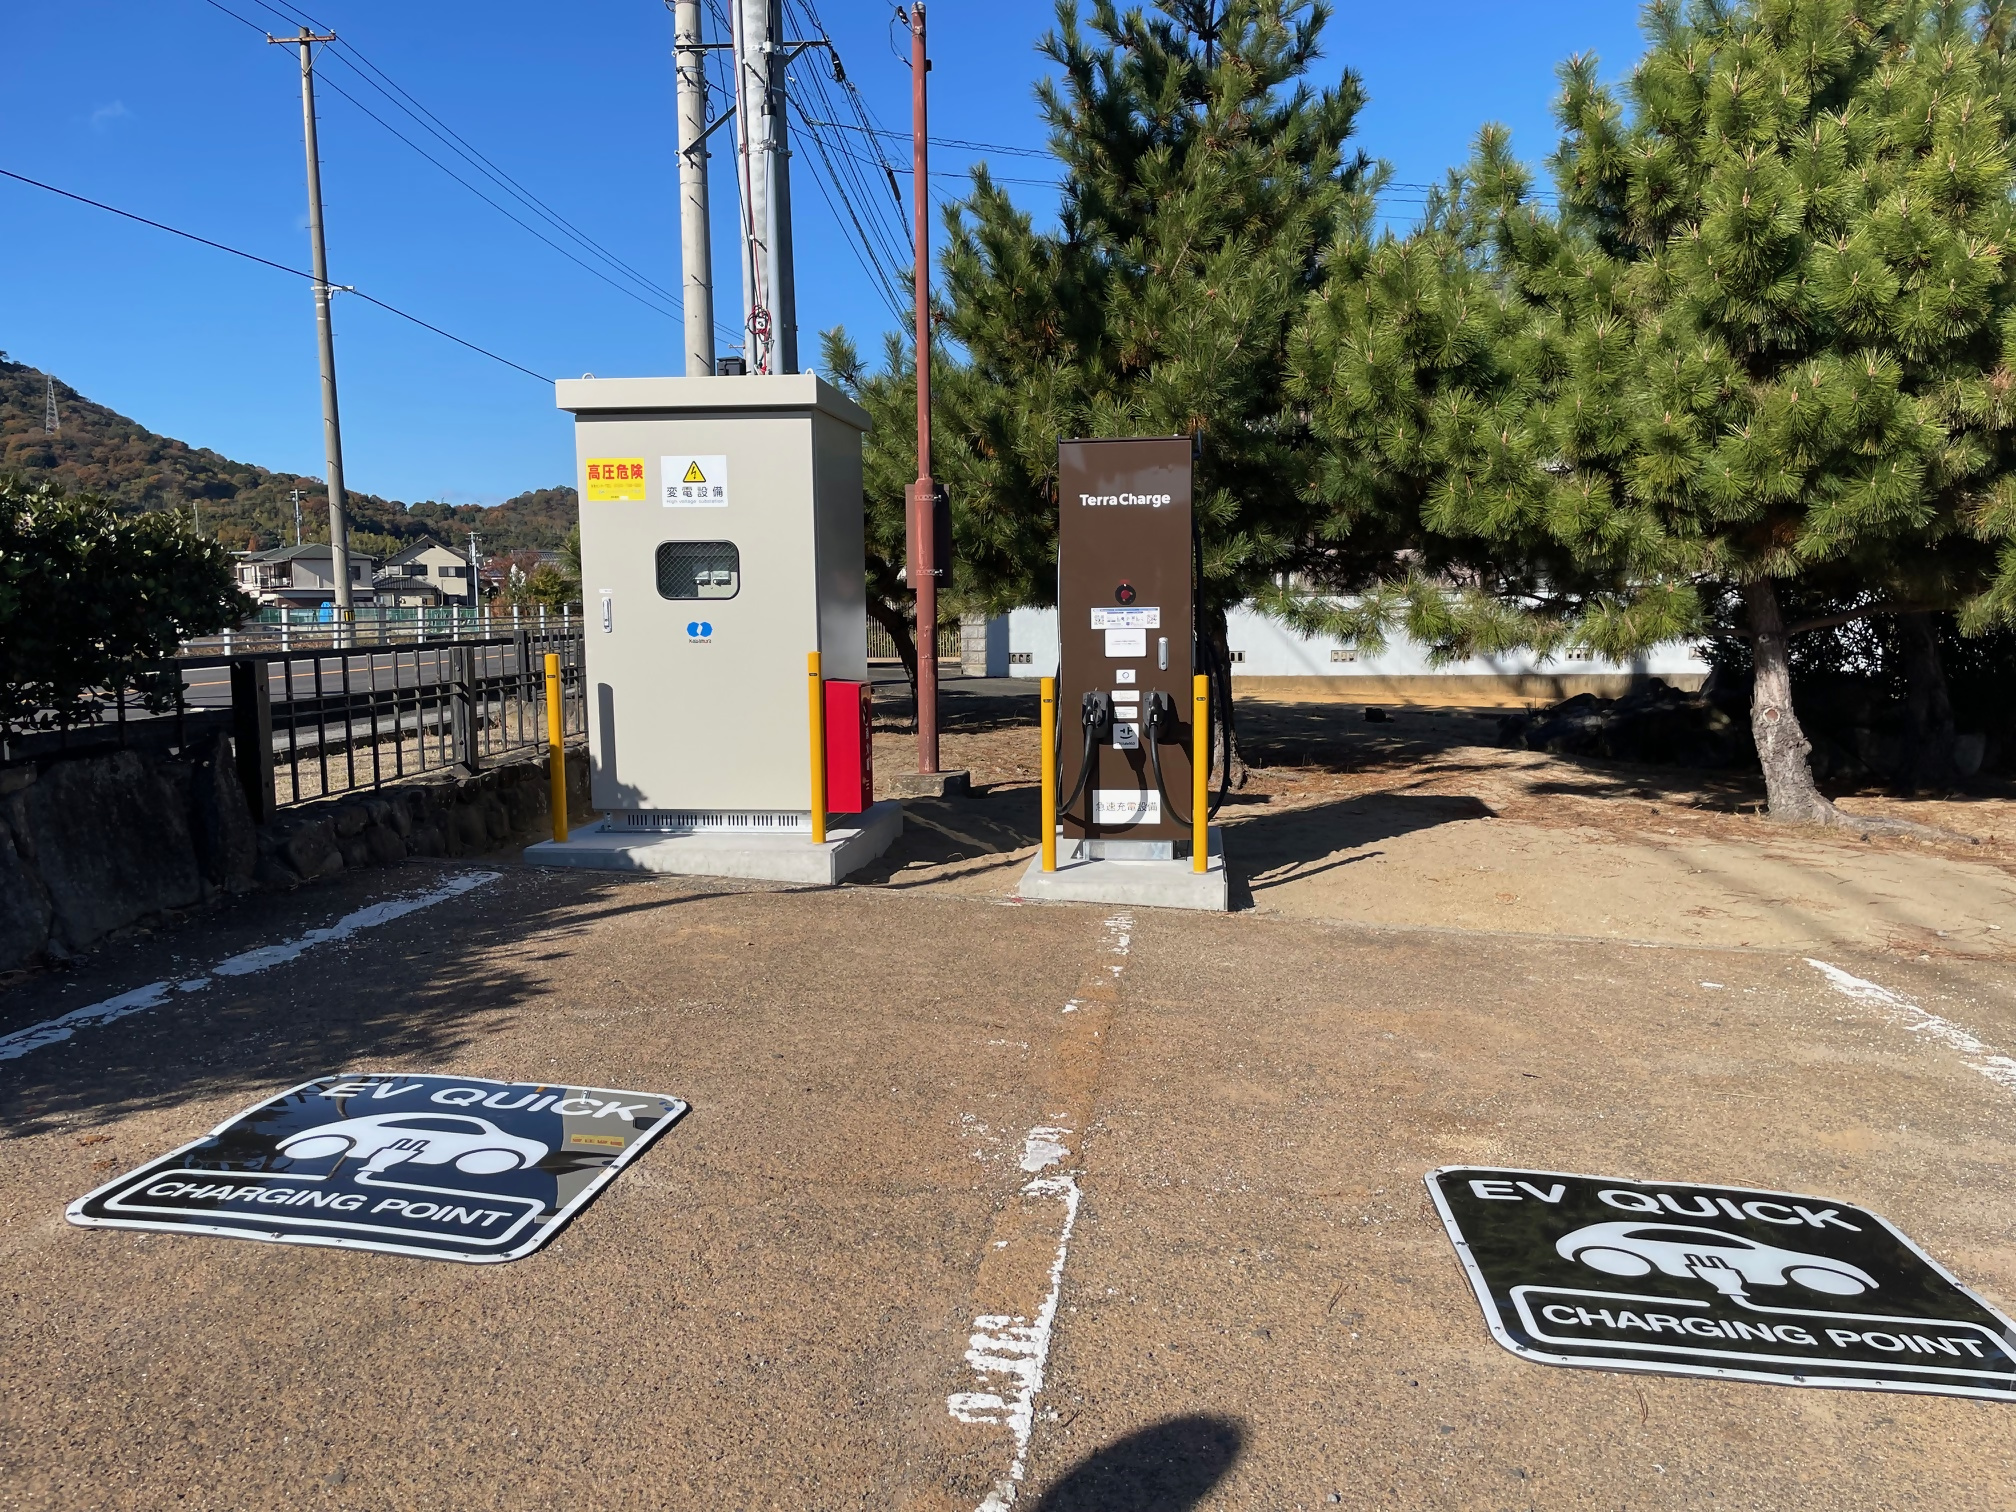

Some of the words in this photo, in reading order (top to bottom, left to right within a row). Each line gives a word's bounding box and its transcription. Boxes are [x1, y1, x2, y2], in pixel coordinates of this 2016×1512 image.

[588, 464, 643, 480] 高圧危険
[666, 486, 723, 498] 変電設備
[1095, 801, 1158, 812] 急速充電設備
[319, 1082, 424, 1099] EV
[430, 1087, 649, 1121] QUICK
[146, 1182, 368, 1211] CHARGING
[370, 1198, 513, 1227] POINT
[1468, 1179, 1567, 1203] EV
[1597, 1189, 1863, 1232] QUICK
[1542, 1304, 1819, 1346] CHARGING
[1824, 1328, 1985, 1358] POINT
